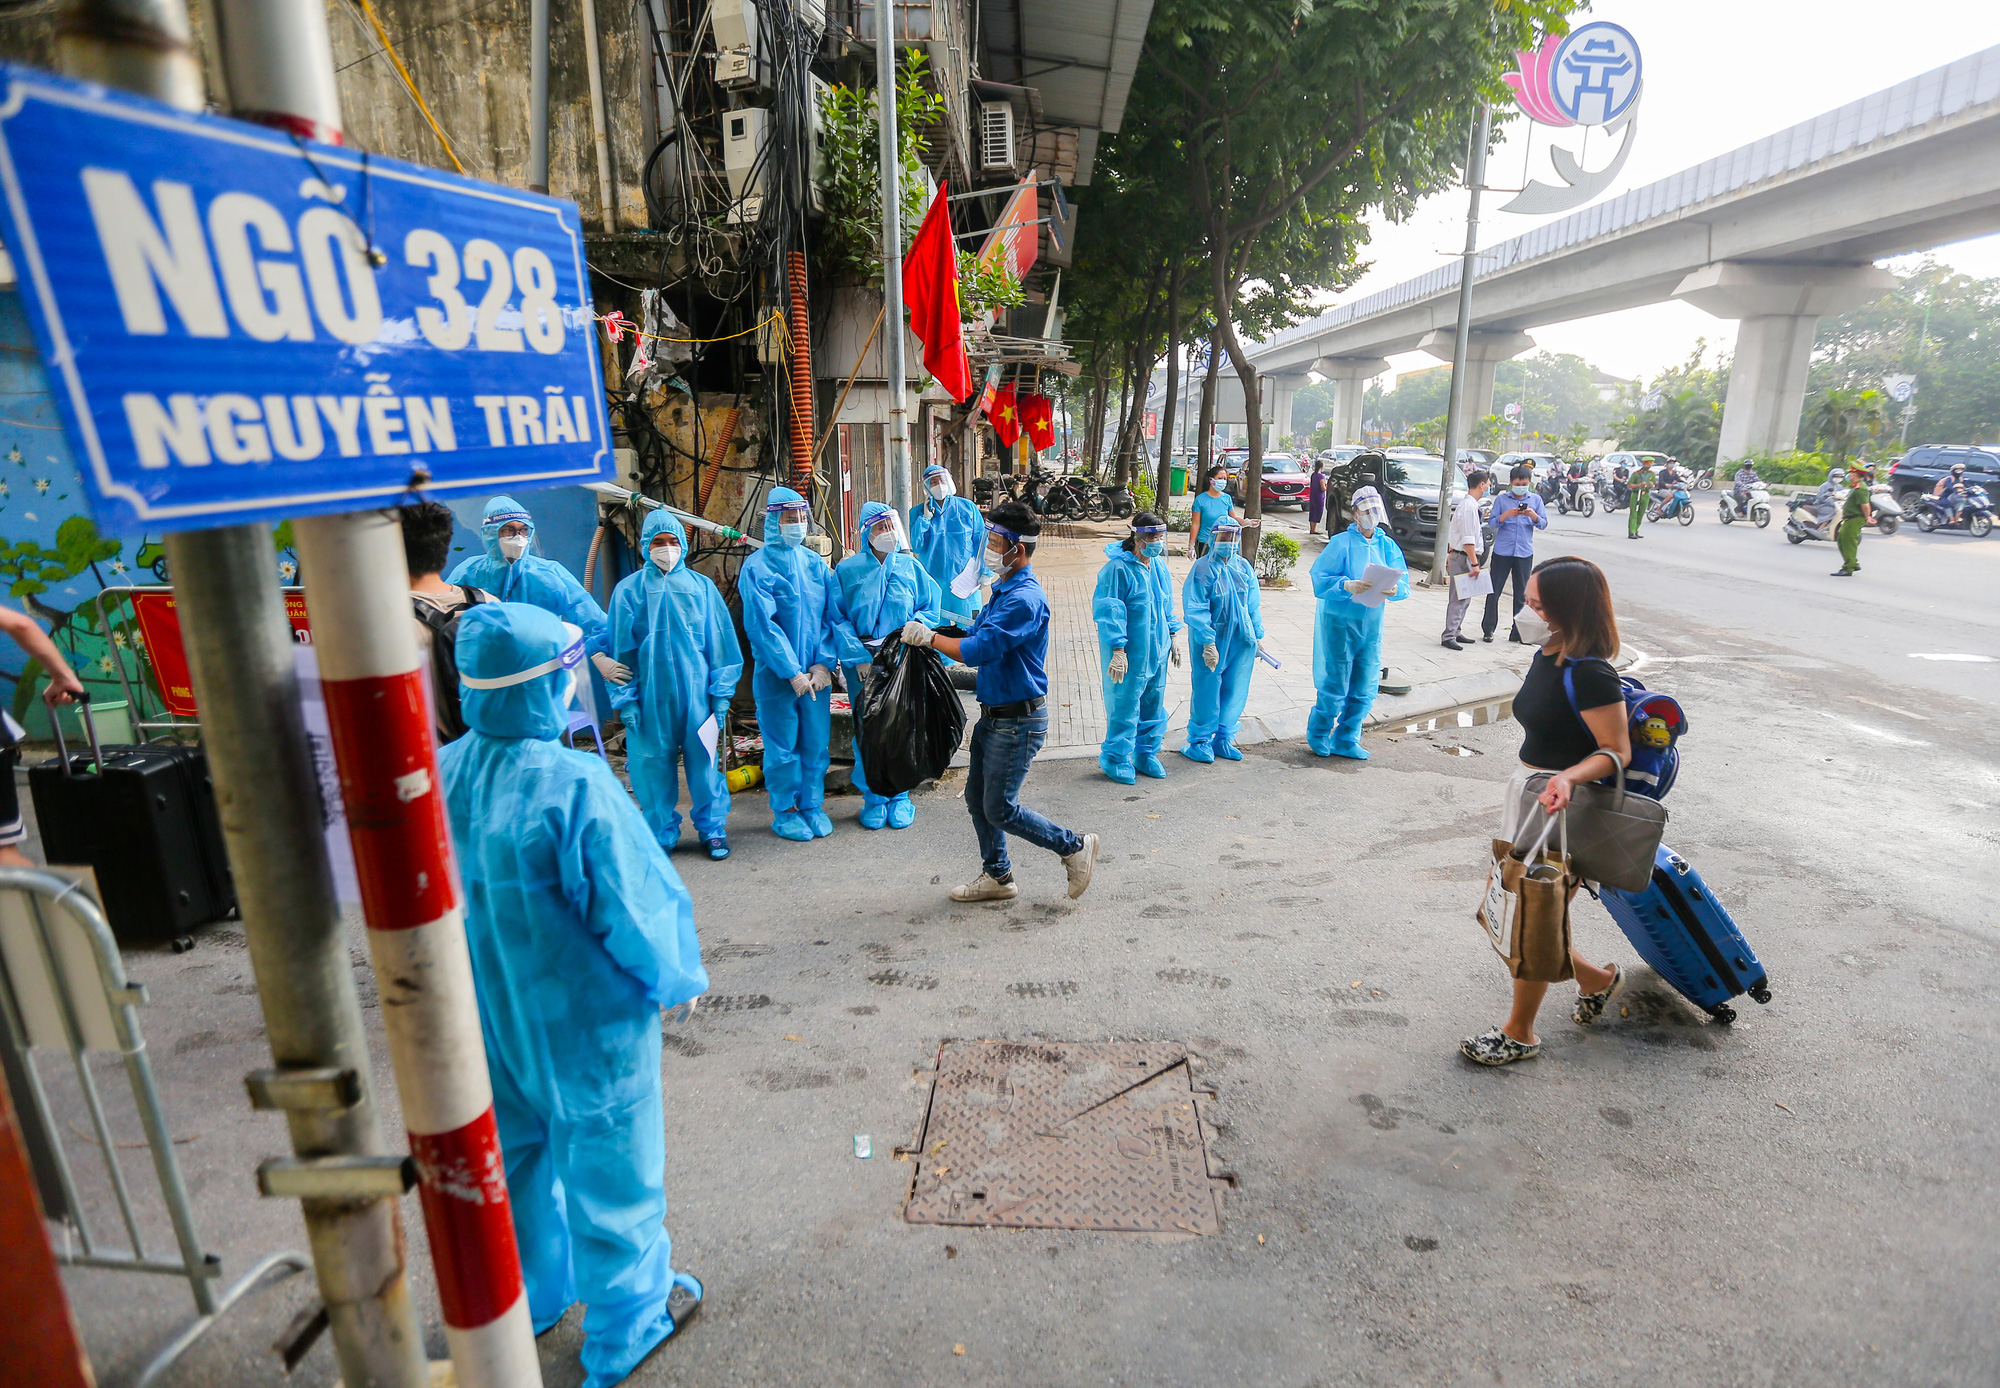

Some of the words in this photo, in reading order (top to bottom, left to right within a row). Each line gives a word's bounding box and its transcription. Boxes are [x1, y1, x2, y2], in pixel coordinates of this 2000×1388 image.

[81, 166, 383, 345] NGÕ
[404, 229, 566, 355] 328
[122, 373, 458, 468] NGUYỄN
[474, 386, 592, 448] TRÃI
[286, 609, 307, 617] UÂN
